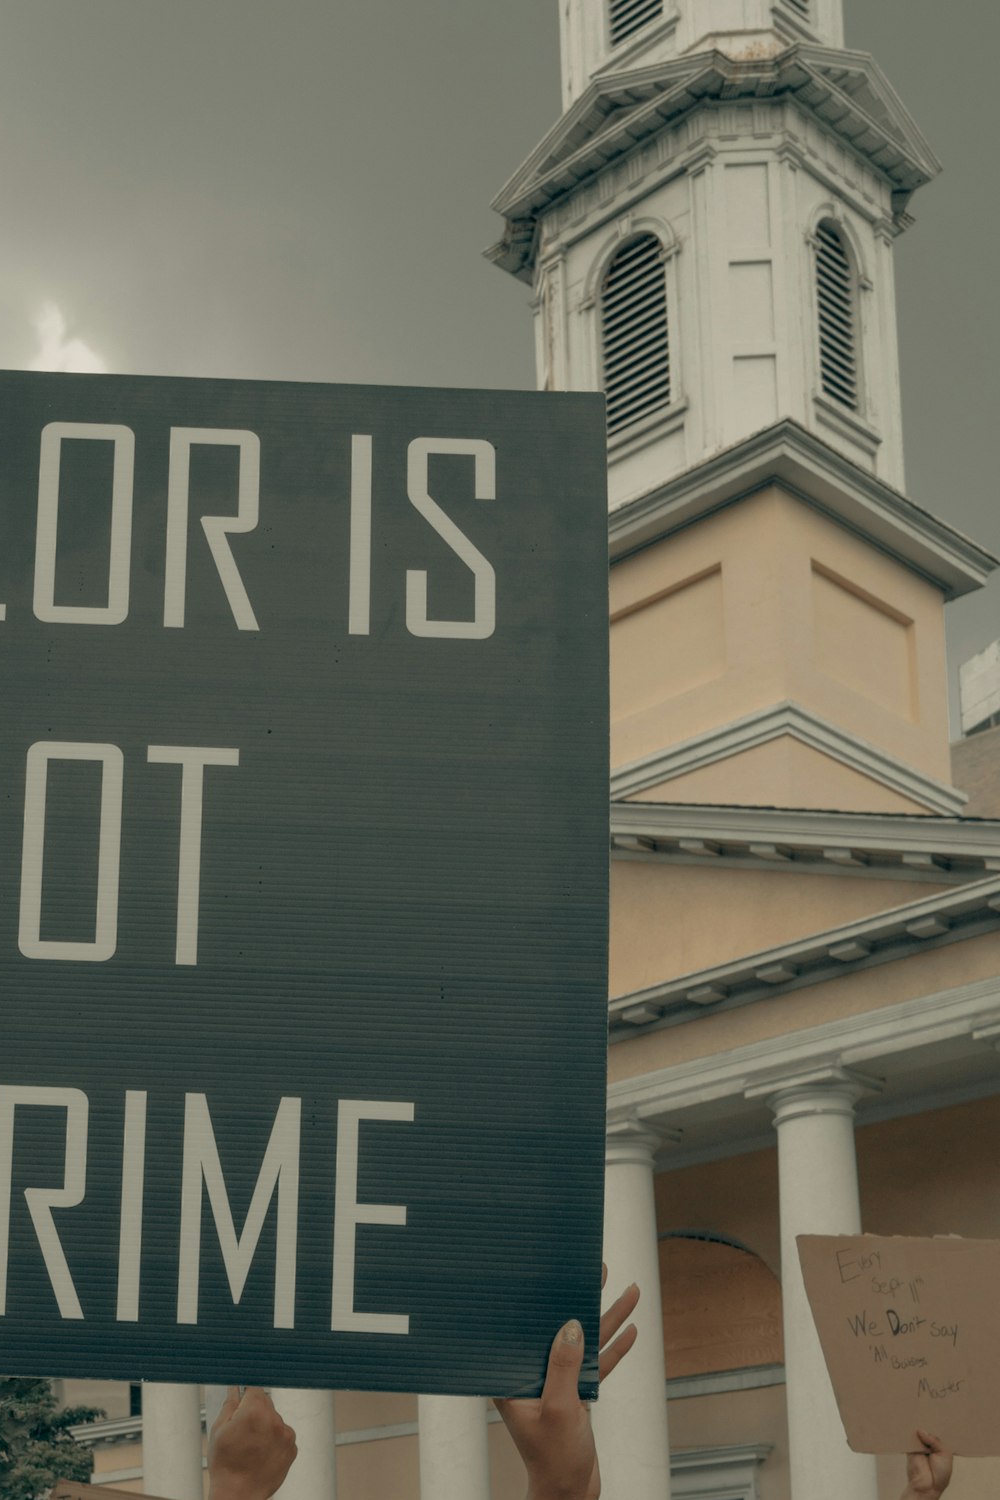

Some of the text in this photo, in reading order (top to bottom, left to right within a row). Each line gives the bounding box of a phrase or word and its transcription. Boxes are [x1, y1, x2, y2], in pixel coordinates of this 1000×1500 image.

[349, 434, 495, 639] IS
[847, 1310, 884, 1337] We
[886, 1309, 927, 1336] Don't
